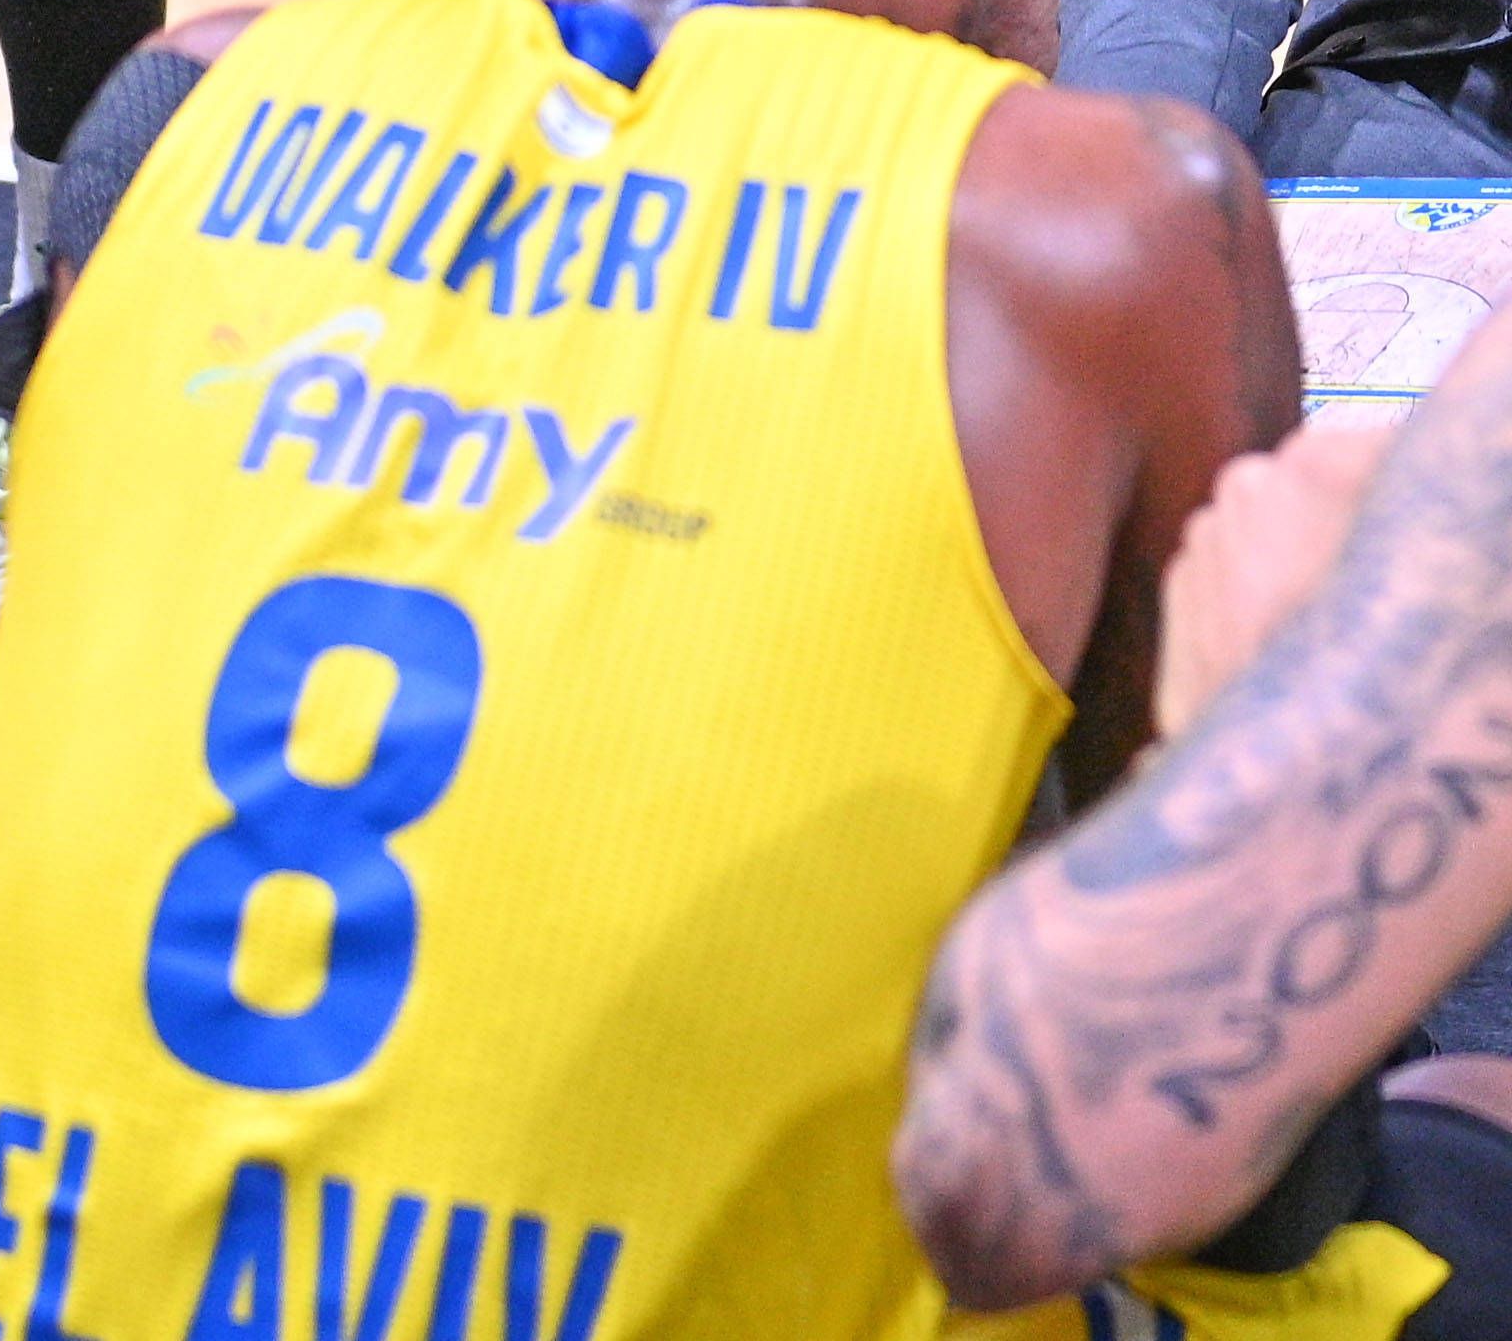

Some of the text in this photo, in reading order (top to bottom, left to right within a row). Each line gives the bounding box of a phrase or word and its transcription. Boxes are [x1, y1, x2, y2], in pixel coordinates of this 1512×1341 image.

[199, 98, 863, 332] WALKER IV
[240, 349, 636, 544] Amy
[143, 574, 484, 1092] 8
[180, 1155, 624, 1341] AVIV
